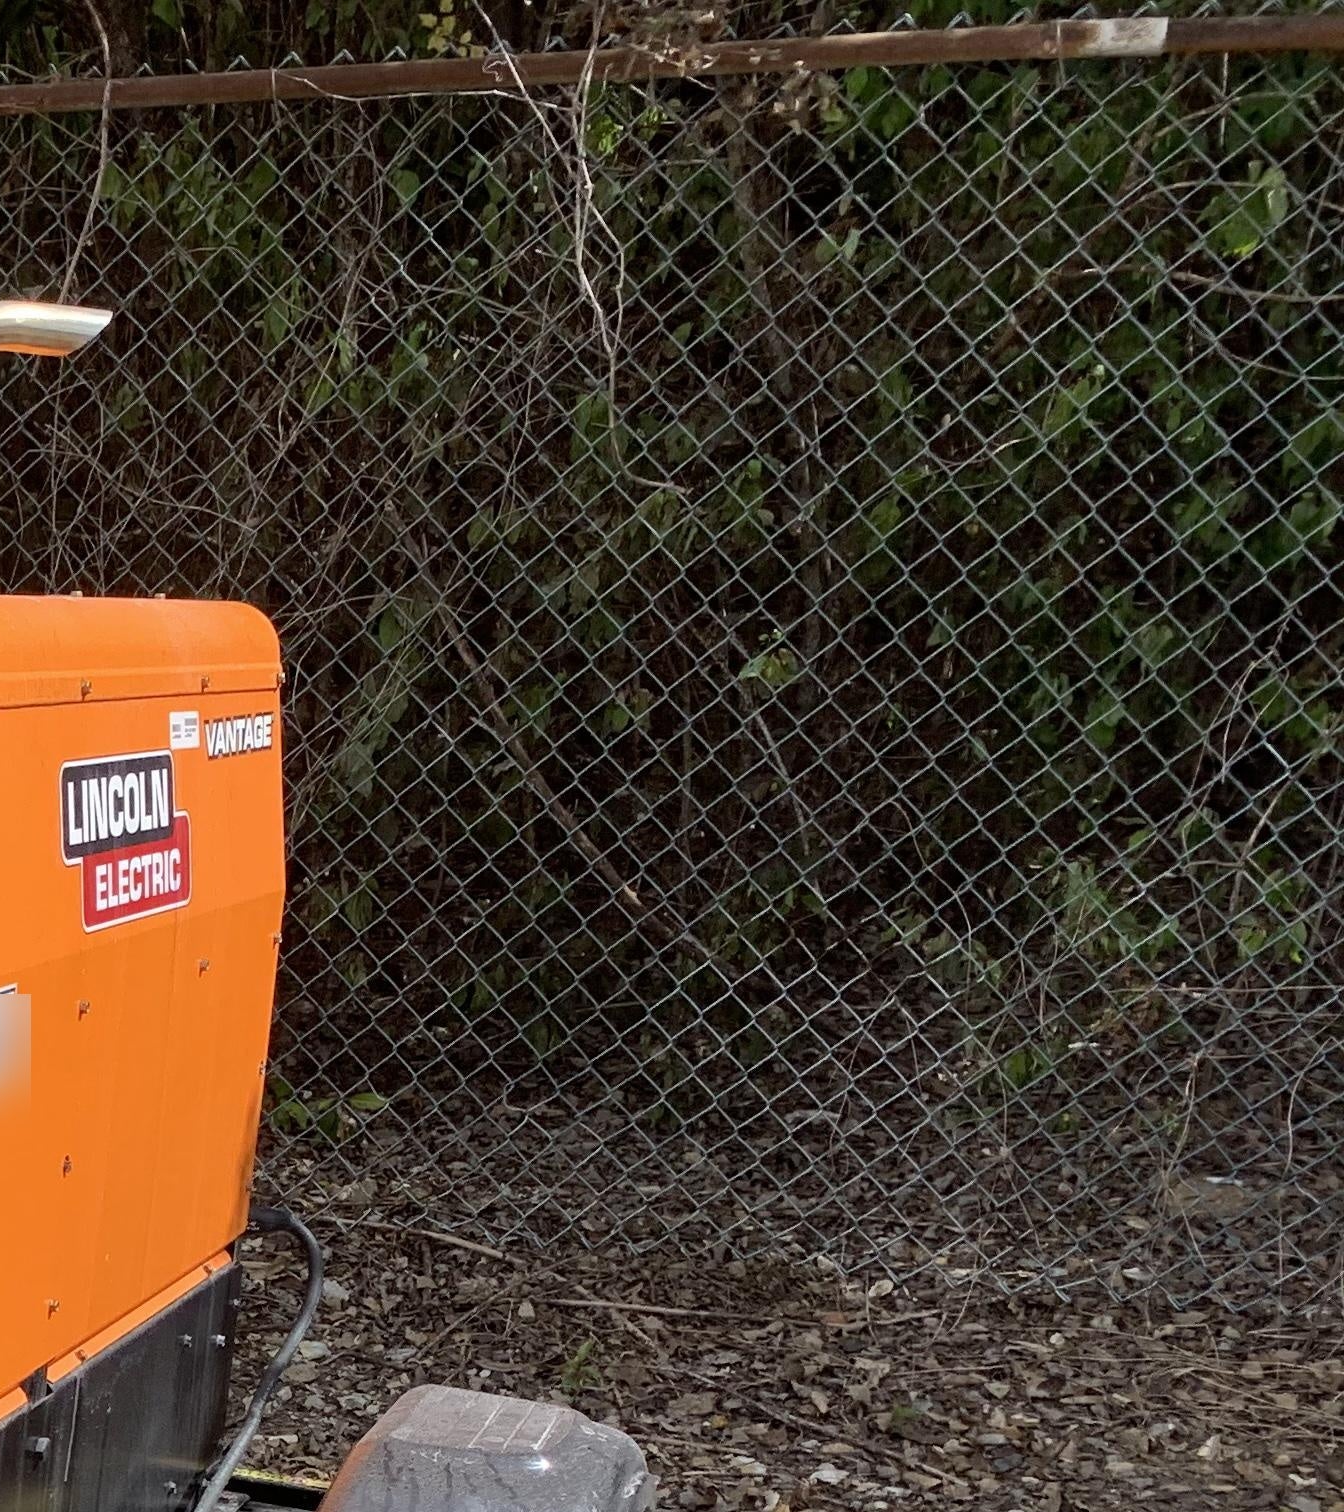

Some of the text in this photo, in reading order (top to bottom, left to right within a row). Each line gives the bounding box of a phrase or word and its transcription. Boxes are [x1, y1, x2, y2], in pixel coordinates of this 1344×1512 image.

[204, 713, 274, 759] VANTAGE
[67, 768, 170, 846] LINCOLN
[95, 848, 181, 912] ELECTRIC
